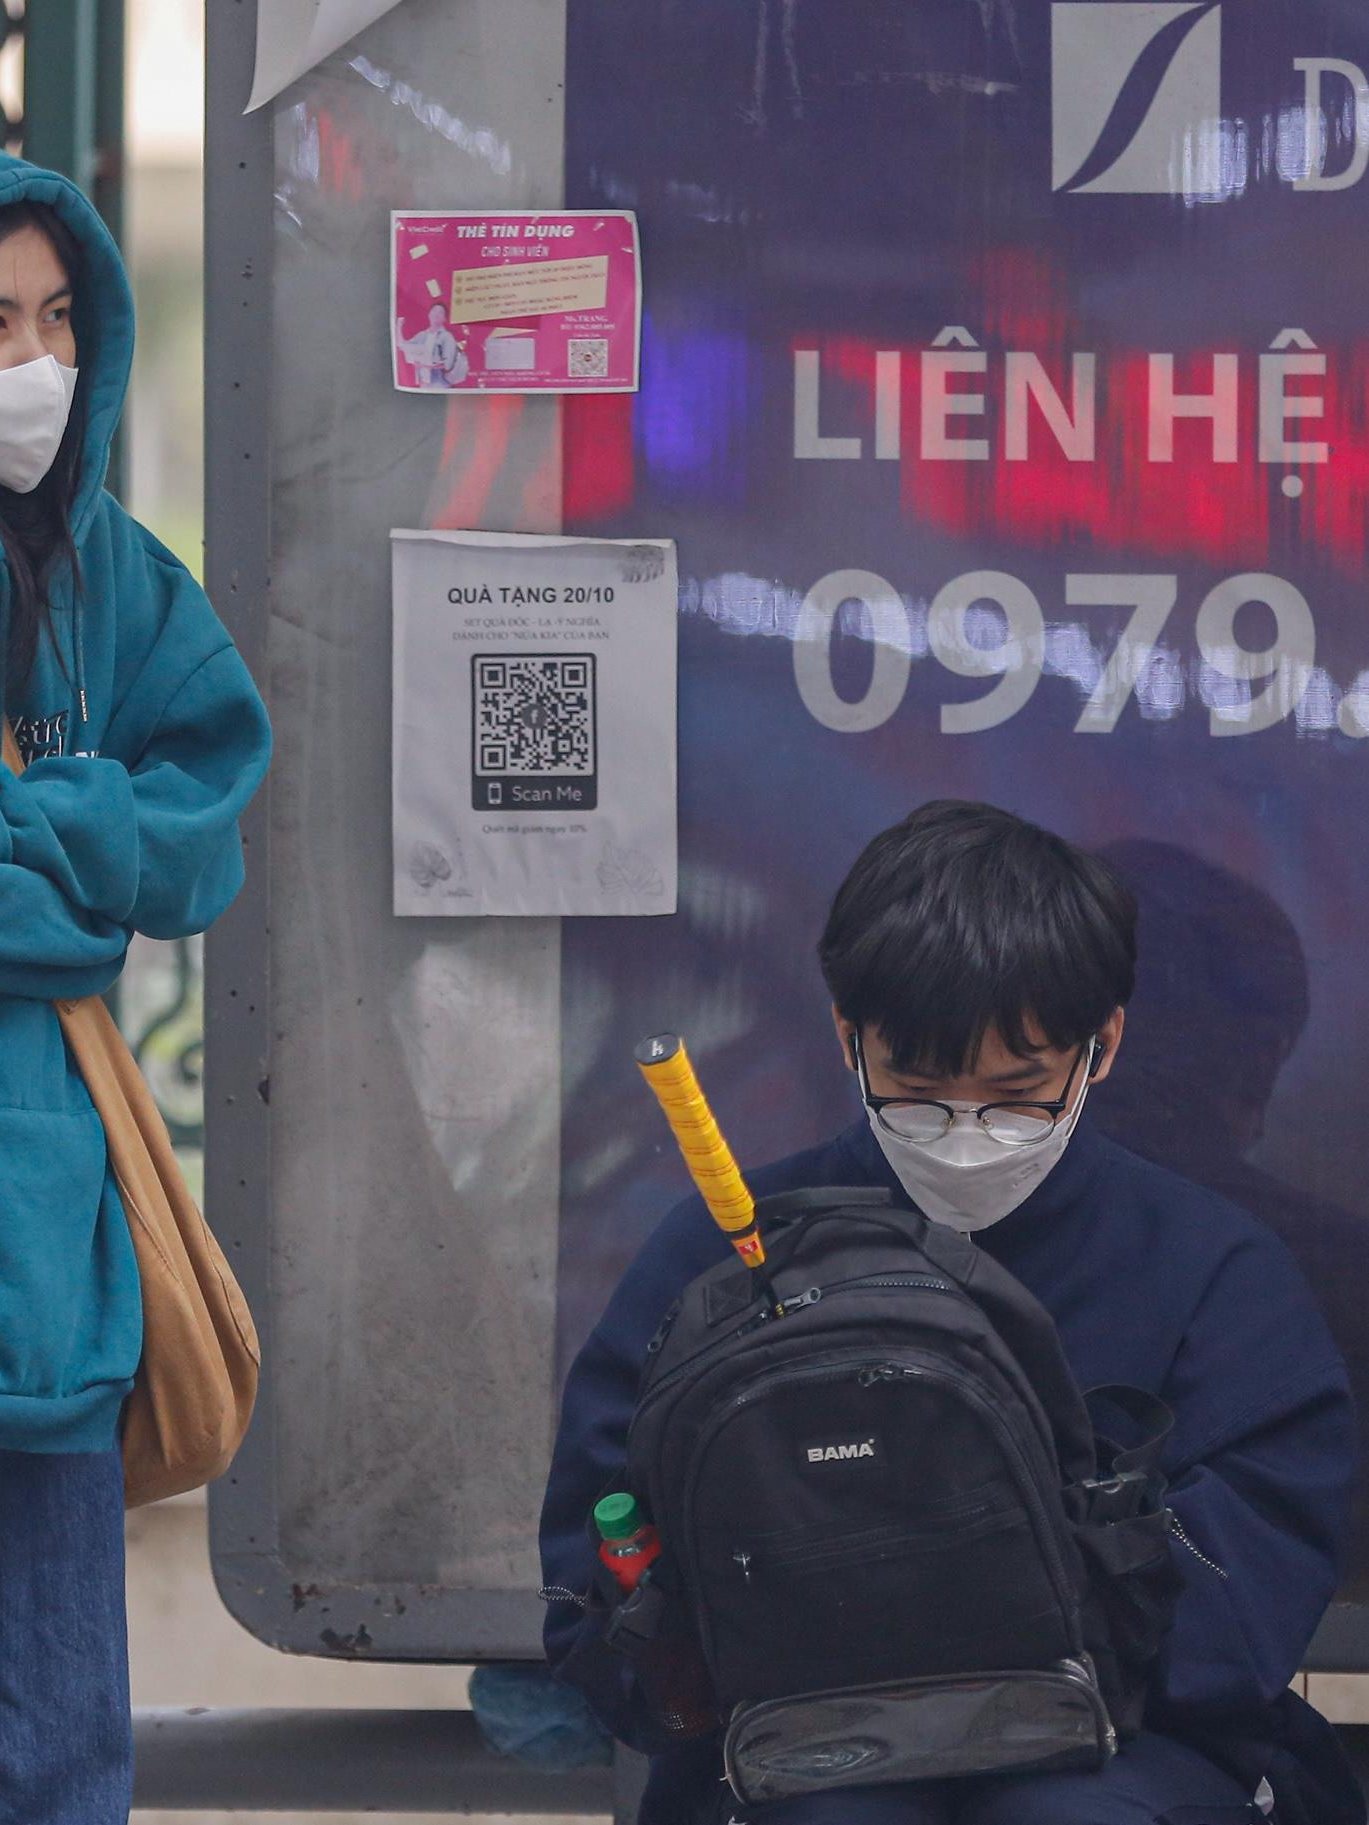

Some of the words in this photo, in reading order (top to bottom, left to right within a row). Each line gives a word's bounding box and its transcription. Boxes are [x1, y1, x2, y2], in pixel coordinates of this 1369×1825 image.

[457, 222, 487, 238] THẺ
[492, 222, 520, 238] TÍN
[524, 224, 575, 241] DỤNG
[794, 326, 1096, 462] LIÊN
[1148, 328, 1329, 498] HỆ
[447, 583, 493, 605] QUÀ
[563, 586, 615, 604] 20/10
[512, 785, 552, 802] Scan
[556, 785, 583, 802] Me
[807, 1442, 874, 1463] BAMA
